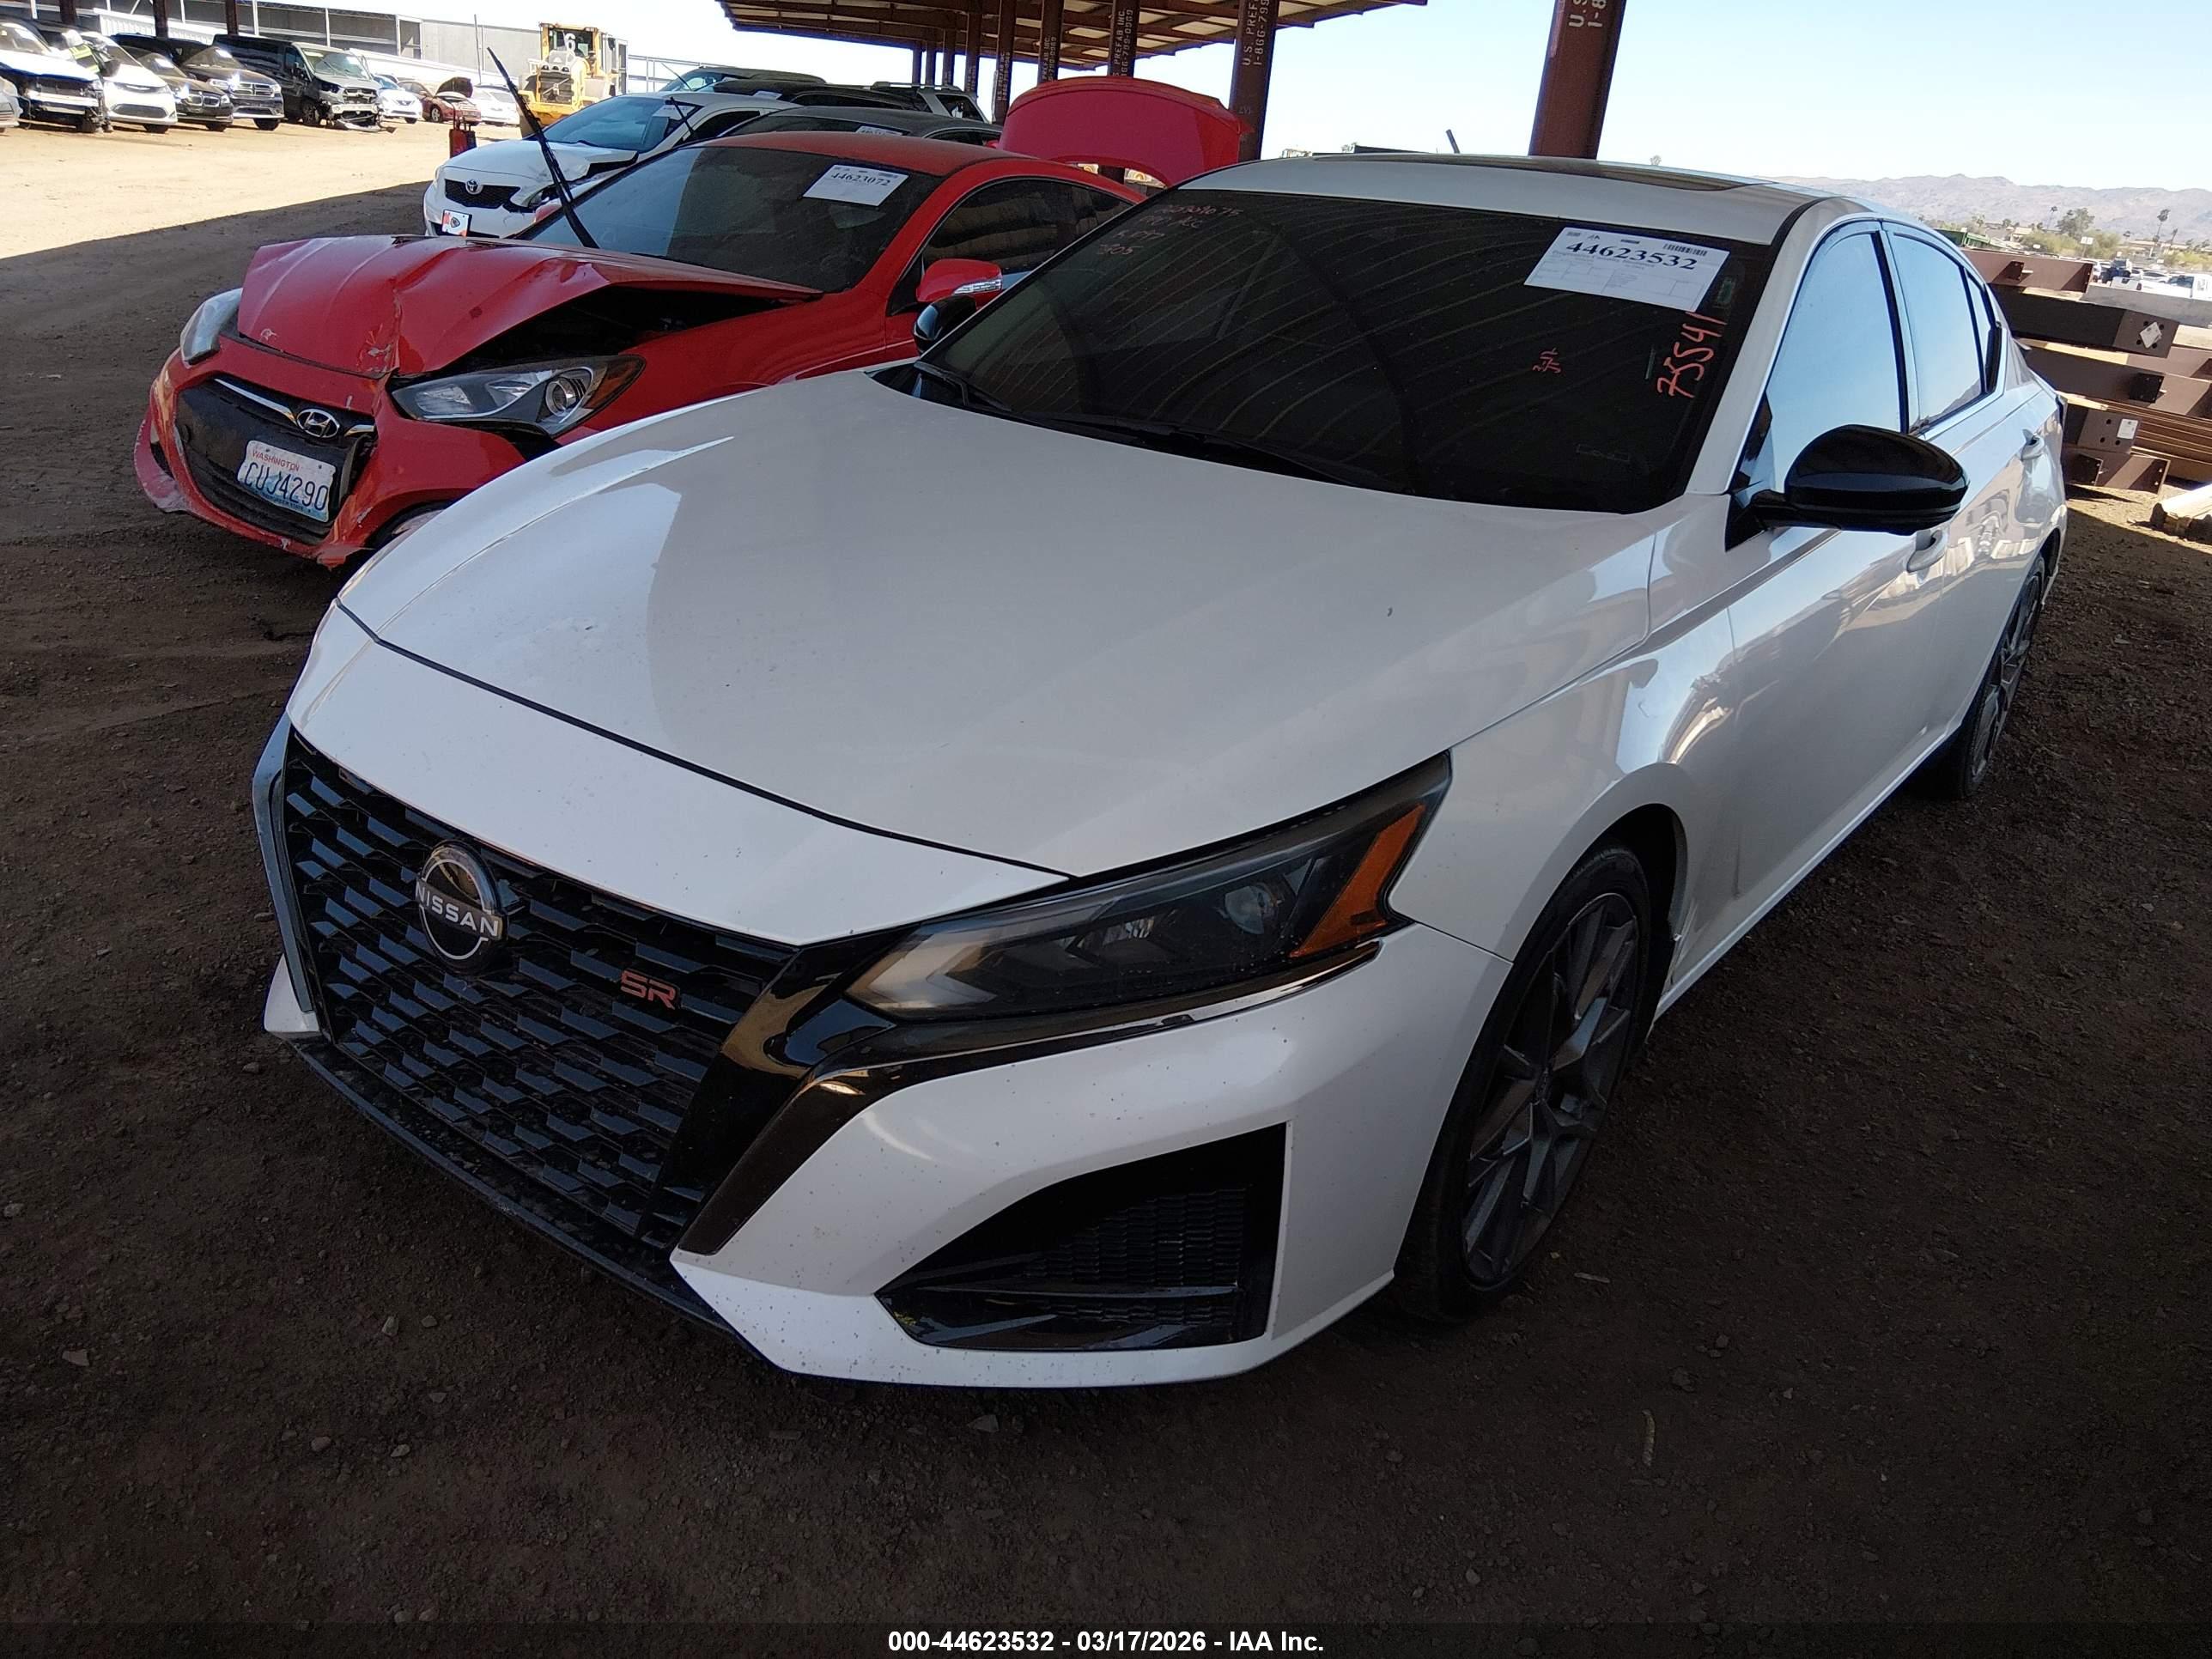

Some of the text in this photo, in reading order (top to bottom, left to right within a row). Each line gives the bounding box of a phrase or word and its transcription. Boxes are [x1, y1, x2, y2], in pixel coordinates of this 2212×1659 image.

[1246, 0, 1259, 34] PREF
[564, 33, 575, 52] 6
[1114, 30, 1123, 65] PREFAB
[831, 172, 891, 186] 44623072
[1565, 241, 1698, 270] 44623532
[252, 449, 301, 472] WASHINGTON
[244, 461, 329, 511] CUJ4290
[415, 880, 499, 937] NISSAN
[620, 969, 677, 1011] SR
